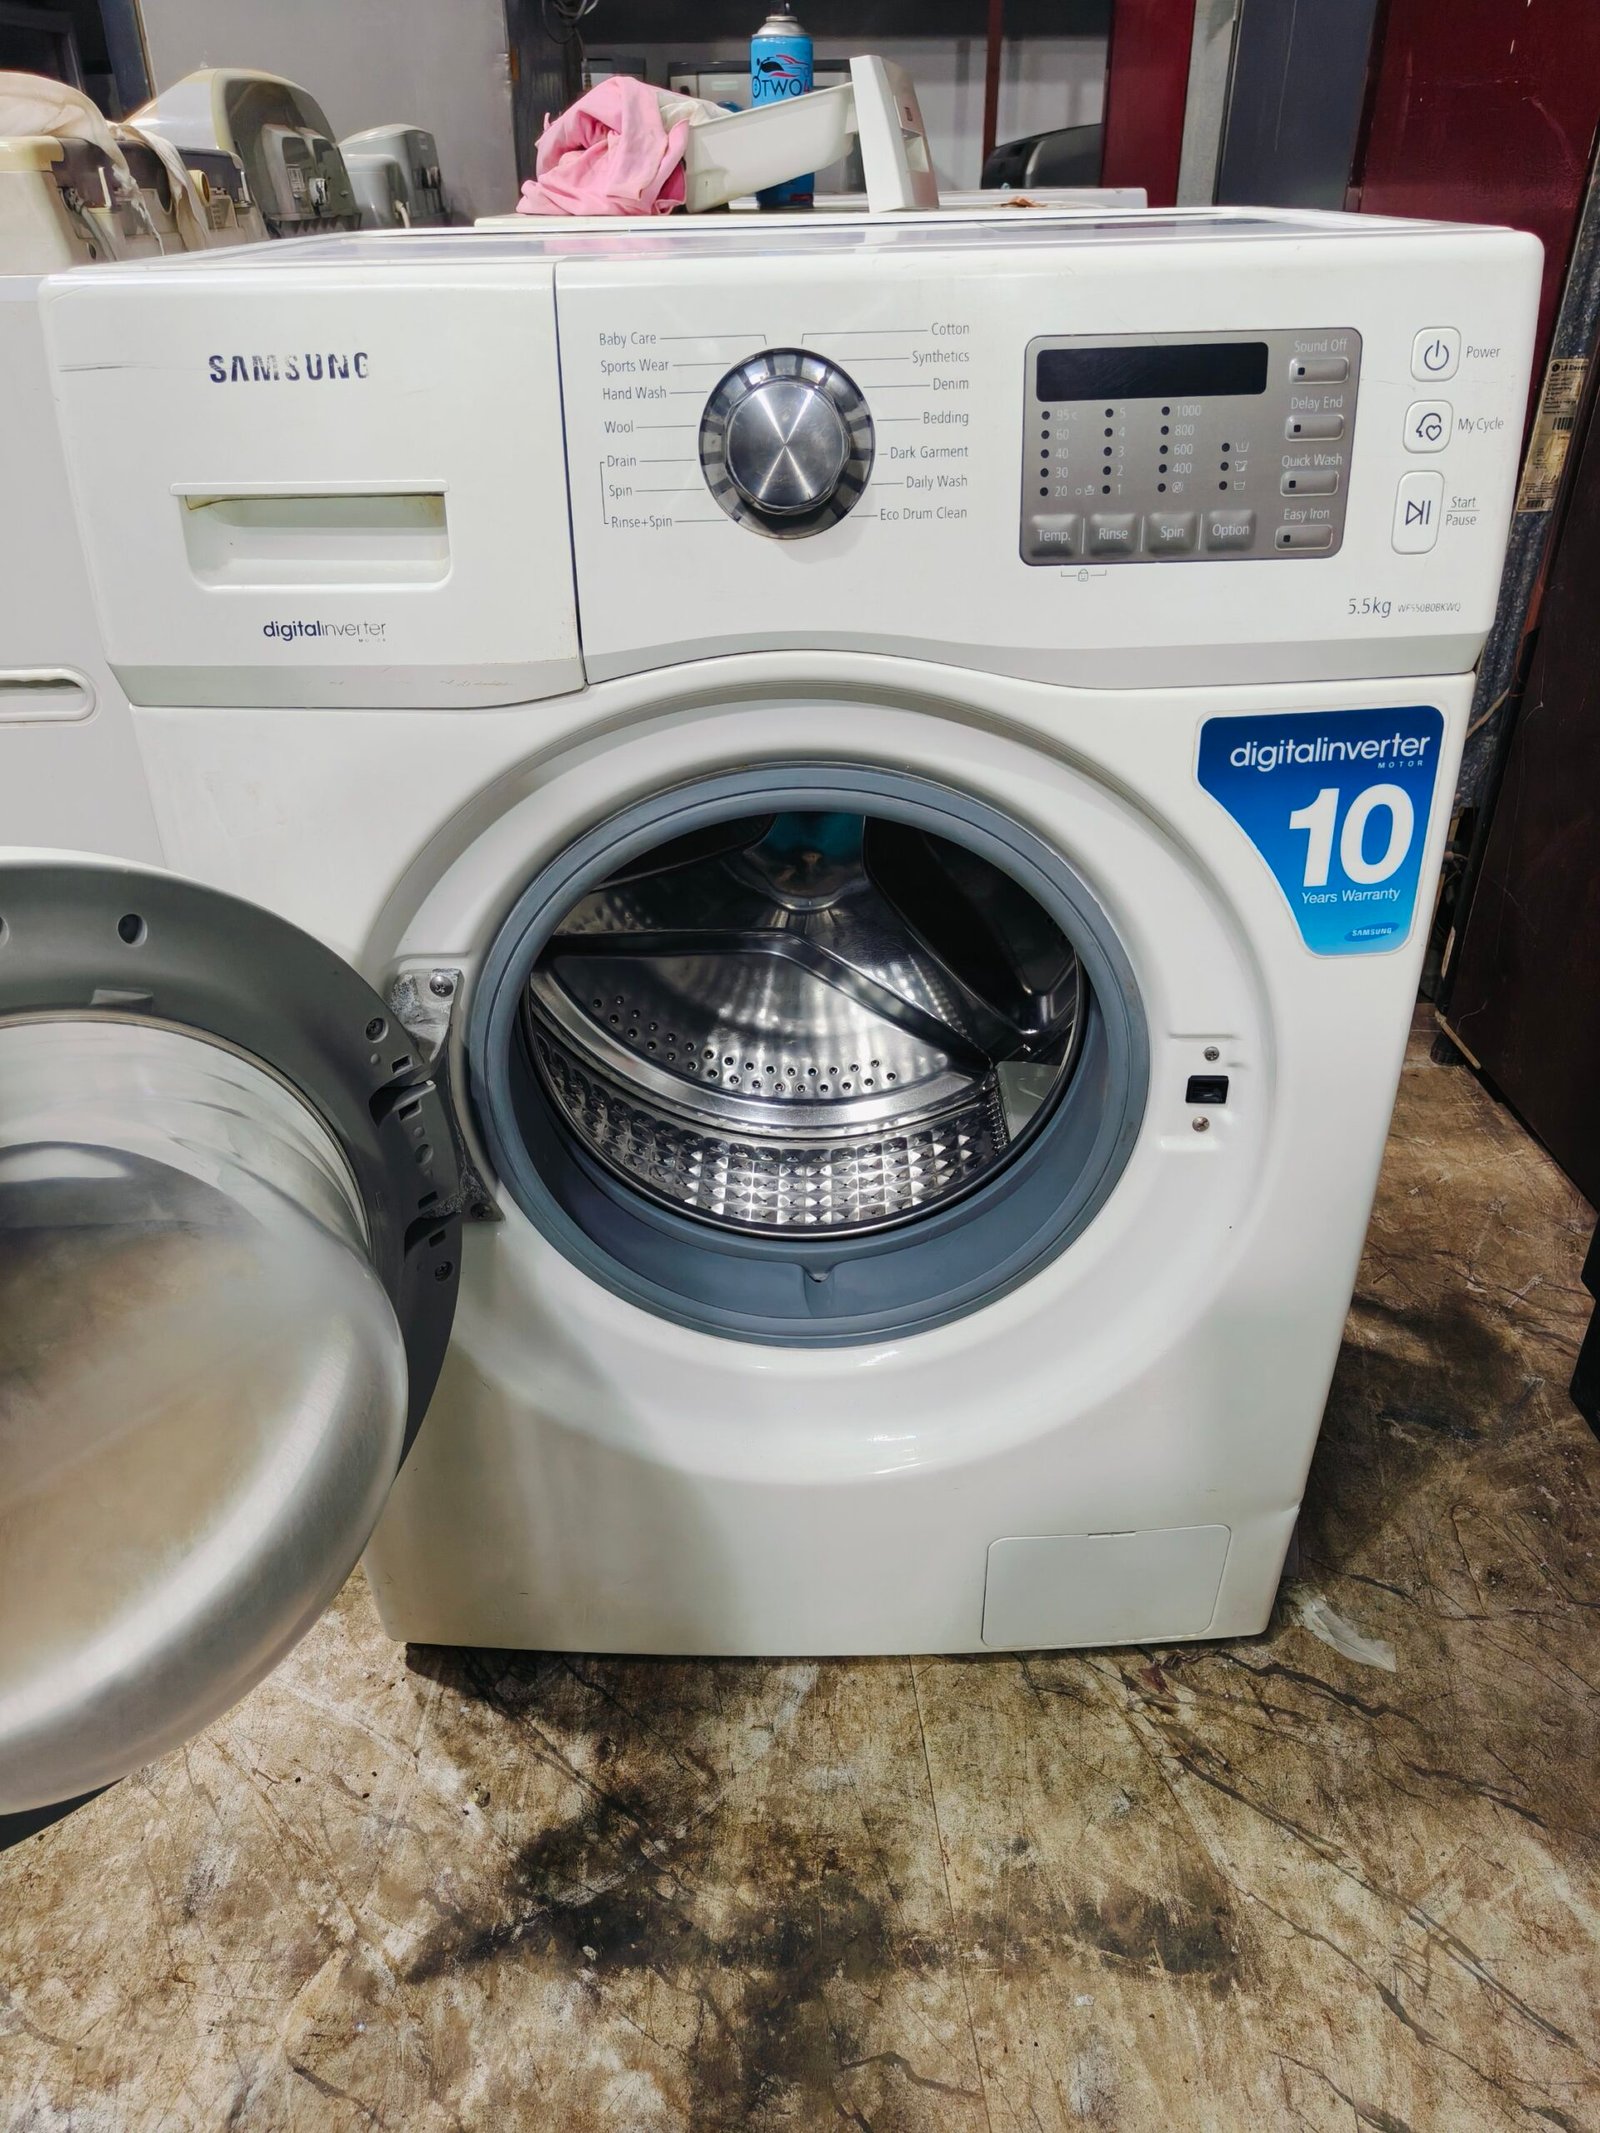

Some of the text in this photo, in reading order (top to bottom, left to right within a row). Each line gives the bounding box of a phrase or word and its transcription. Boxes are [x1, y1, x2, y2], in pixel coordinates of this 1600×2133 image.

[931, 322, 970, 336] Cotton
[600, 331, 657, 349] Baby Care
[1294, 338, 1348, 353] Sound Off
[912, 348, 970, 367] Synthetics
[1465, 345, 1501, 358] Power
[208, 352, 369, 383] SAMSUNG
[600, 358, 669, 376] Sports Wear
[932, 377, 969, 391] Denim
[602, 385, 667, 401] Hand Wash
[1176, 404, 1202, 417] 1000
[1290, 394, 1343, 412] Delay End
[923, 410, 969, 427] Bedding
[1119, 407, 1126, 419] 5
[603, 419, 634, 434] Wool
[1118, 426, 1126, 437] 4
[1174, 424, 1194, 437] 800
[1458, 416, 1504, 434] My Cycle
[1055, 428, 1070, 441] 60
[890, 444, 969, 460] Dark Garment
[1055, 447, 1070, 460] 40
[1117, 445, 1125, 458] 3
[1173, 443, 1193, 456] 600
[606, 454, 637, 468] Drain
[1172, 462, 1192, 474] 400
[1281, 452, 1343, 469] Quick Wash
[1055, 466, 1069, 479] 30
[1116, 464, 1124, 477] 2
[905, 474, 968, 492] Daily Wash
[608, 484, 633, 500] Spin
[1054, 485, 1068, 498] 20
[1450, 495, 1477, 509] Start
[879, 506, 968, 521] Eco Drum Clean
[1283, 507, 1331, 524] Easy Iron
[1445, 513, 1477, 527] Pause
[610, 515, 673, 530] Rinse+Spin
[1037, 529, 1072, 543] Temp.
[1098, 527, 1129, 541] Rinse
[1160, 526, 1185, 541] Spin
[1212, 523, 1250, 540] Option
[1347, 597, 1392, 619] 5.5kg
[263, 620, 387, 642] digitalinverter
[1229, 732, 1431, 773] digitalinverter
[1377, 759, 1424, 769] MOTOR
[1289, 783, 1415, 888] 10
[1301, 888, 1401, 905] Years Warranty
[1351, 926, 1393, 937] SAMSUNG
